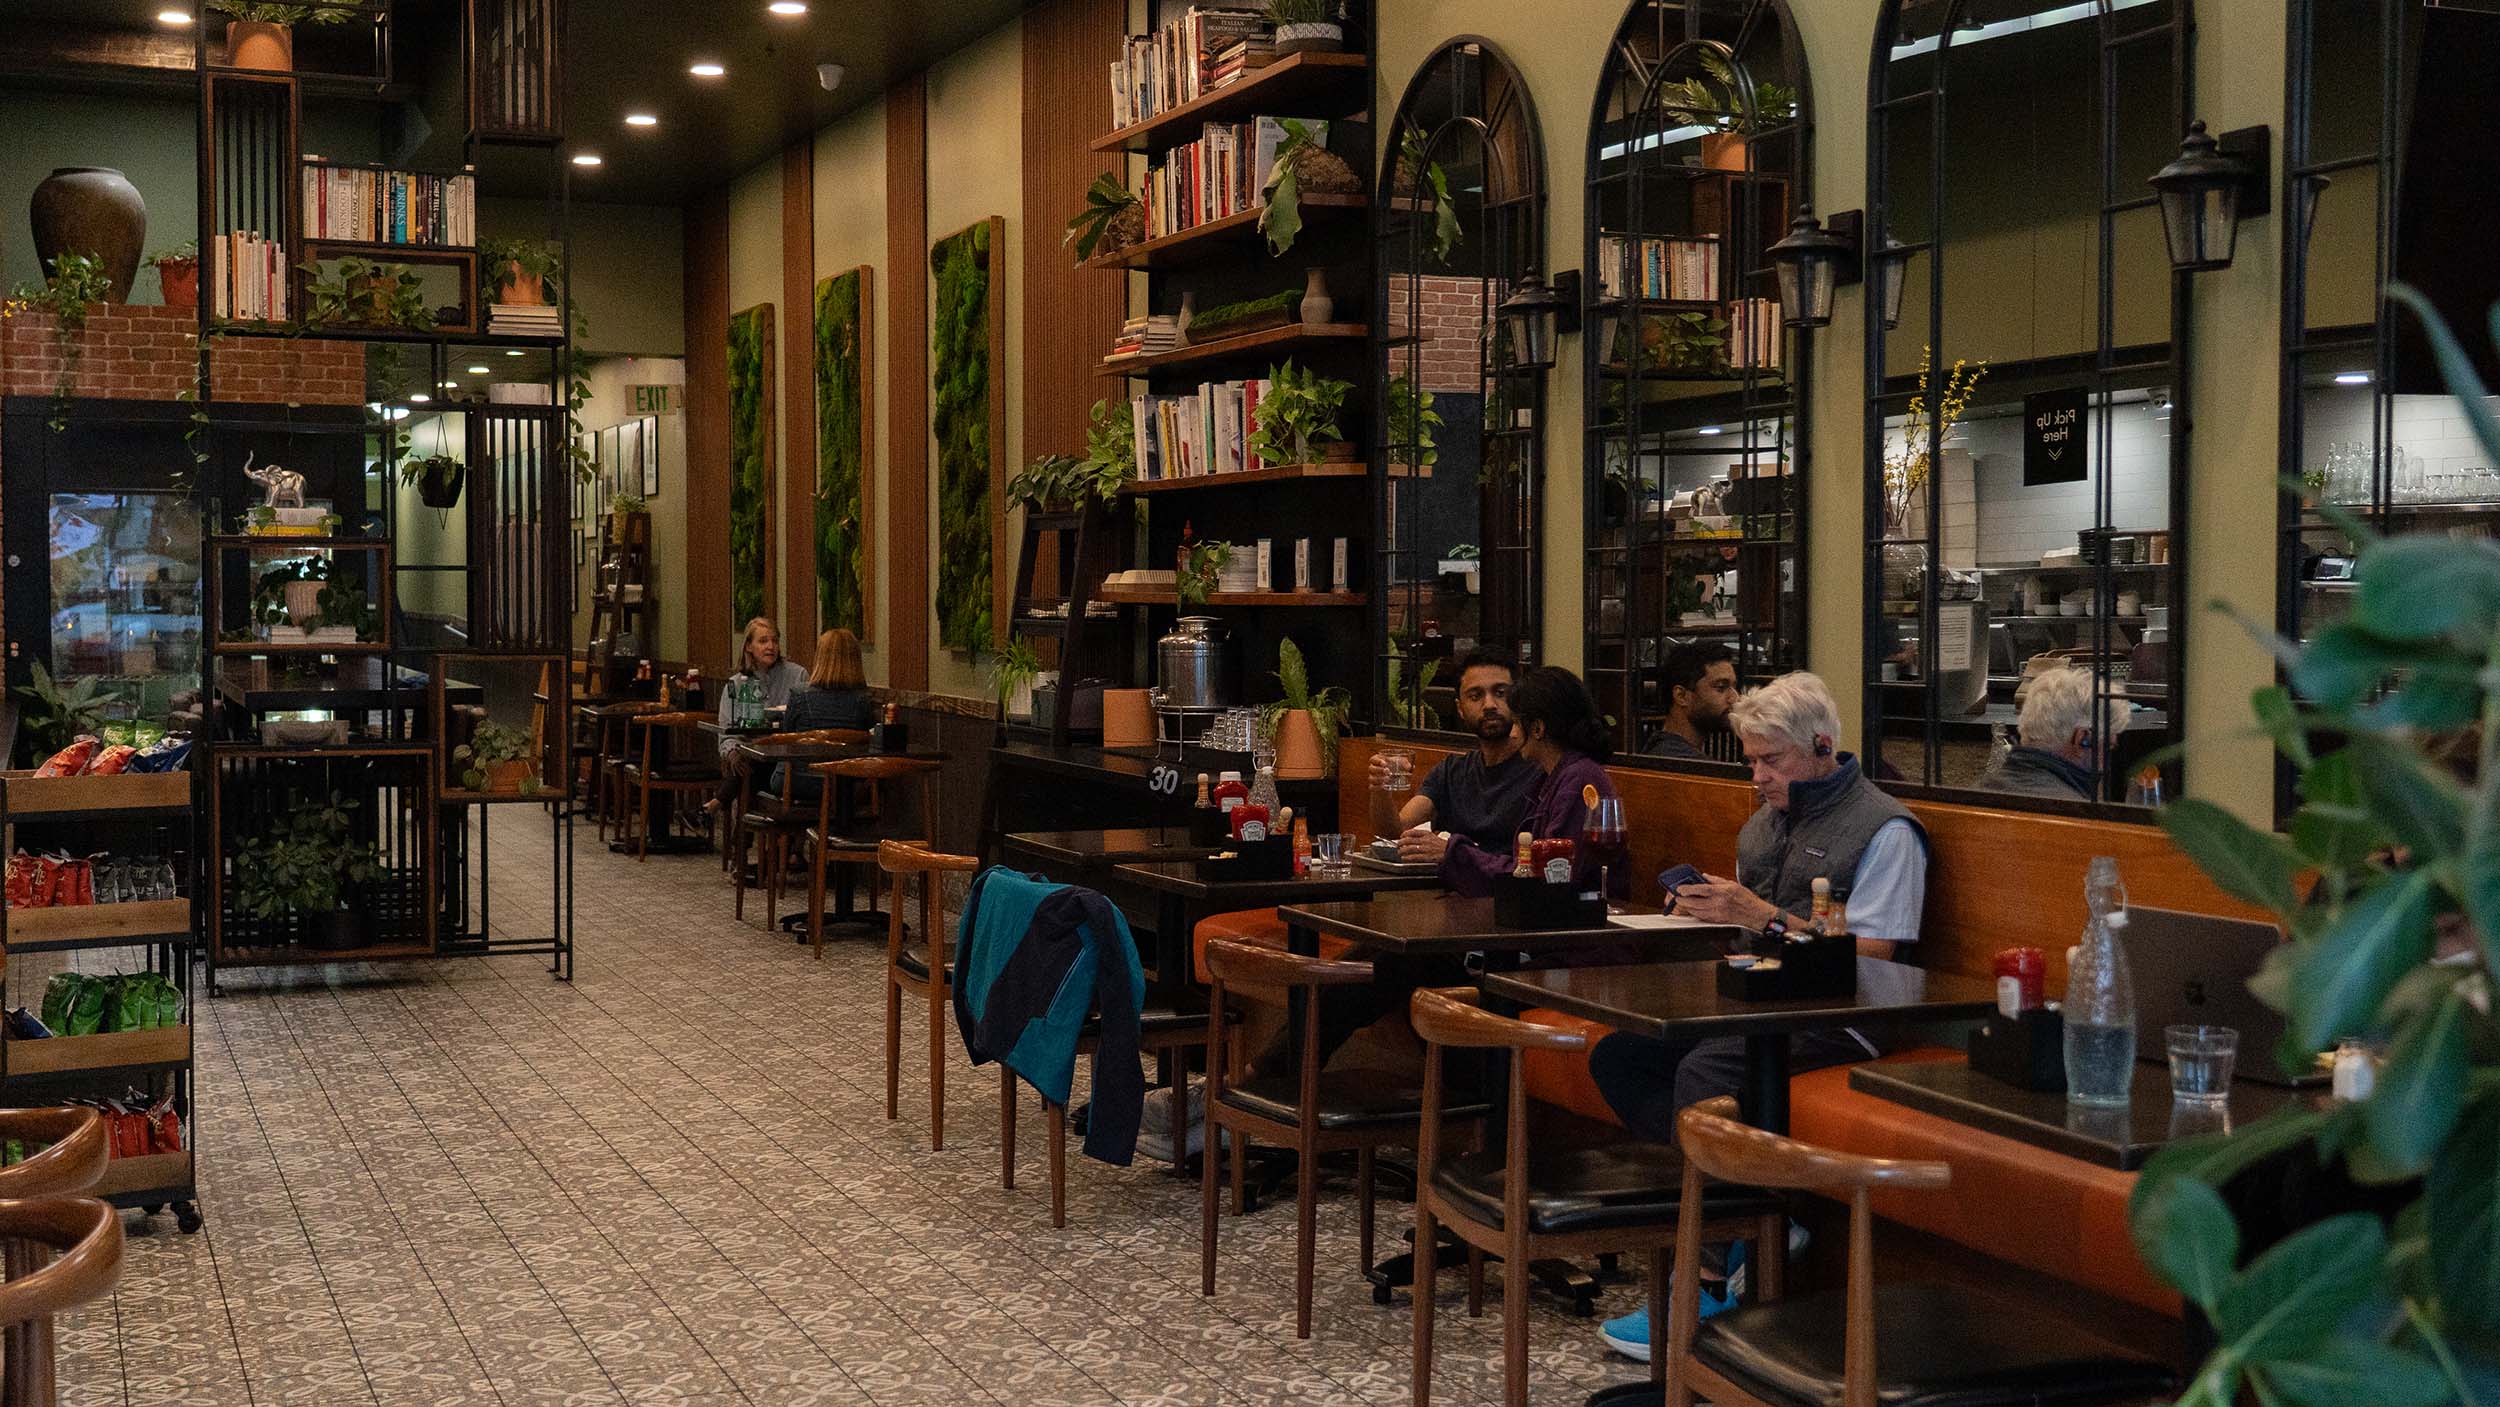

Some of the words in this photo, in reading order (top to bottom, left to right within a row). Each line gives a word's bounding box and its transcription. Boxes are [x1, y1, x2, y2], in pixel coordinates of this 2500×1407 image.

[339, 191, 347, 233] COOKING
[397, 187, 406, 225] DRINKS
[636, 385, 668, 411] EXIT
[1149, 766, 1179, 795] 30
